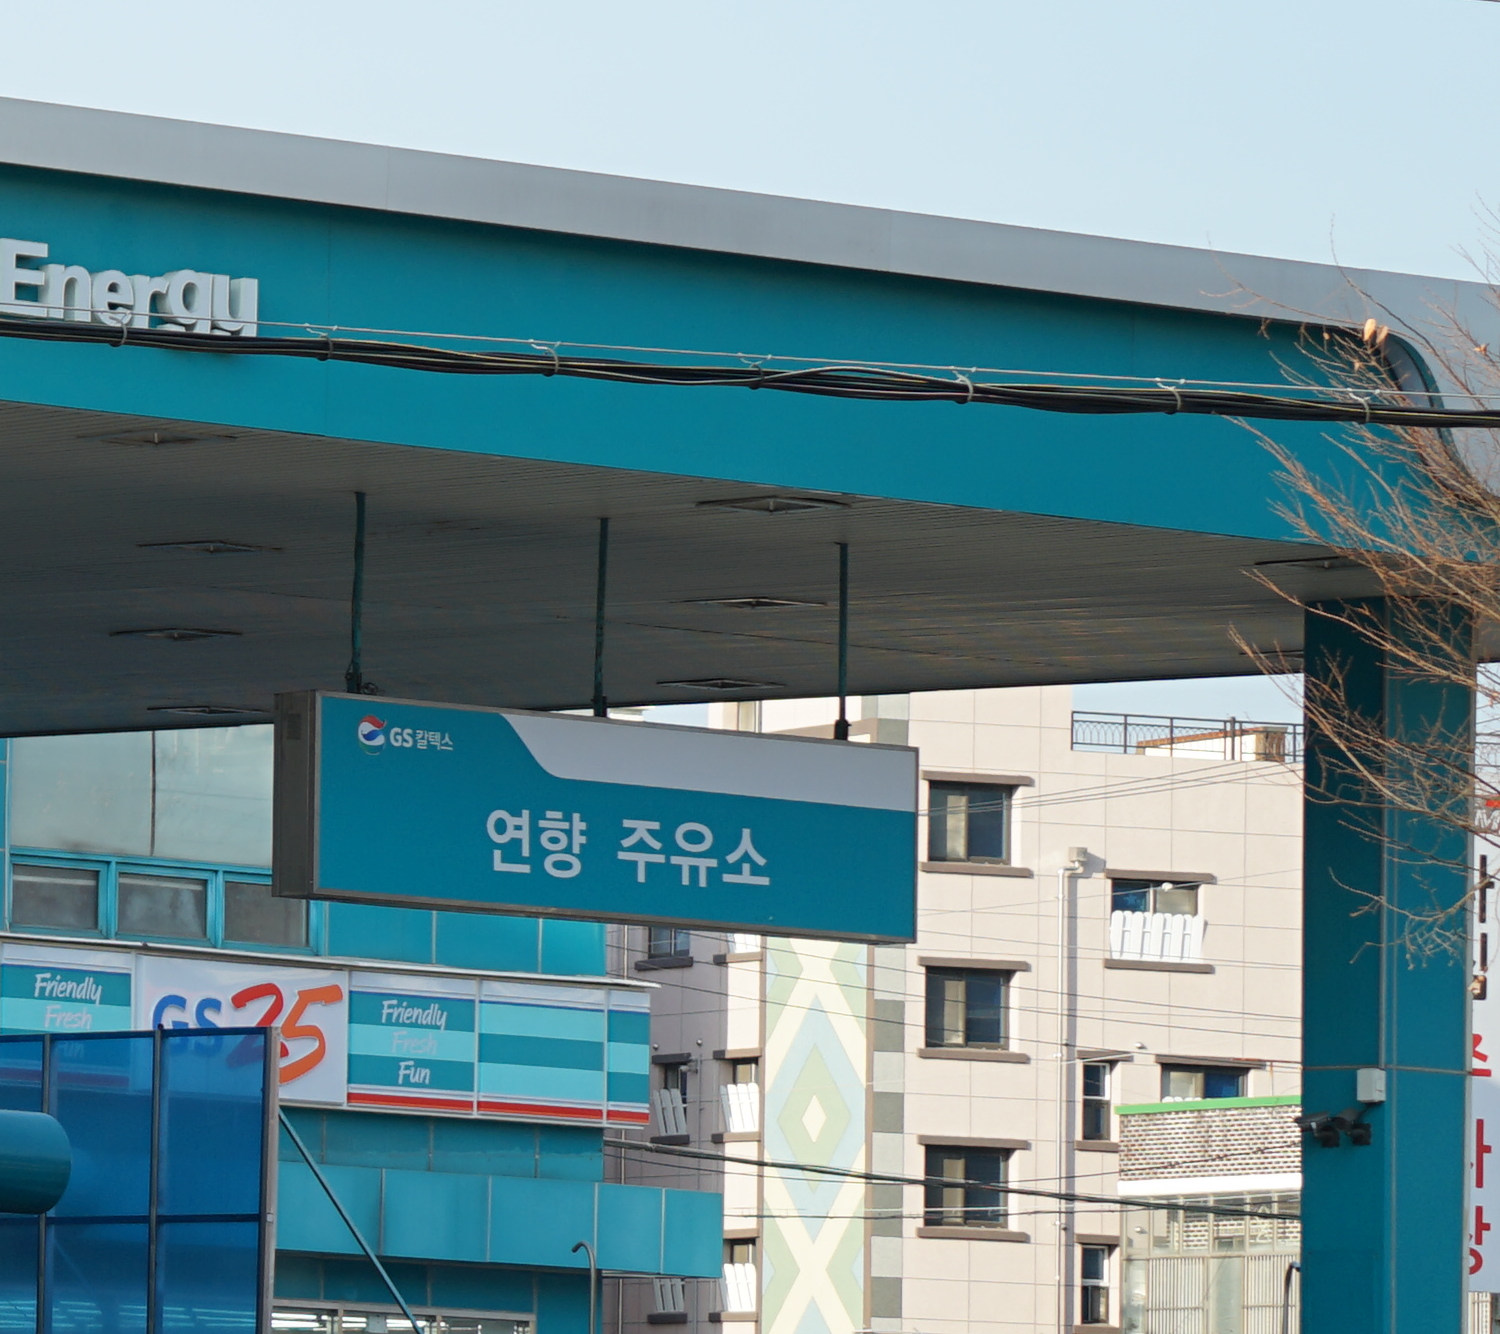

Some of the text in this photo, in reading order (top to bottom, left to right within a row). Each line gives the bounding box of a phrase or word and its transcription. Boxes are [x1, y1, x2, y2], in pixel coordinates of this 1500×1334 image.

[485, 808, 773, 888] 연향 주유소
[33, 973, 103, 1005] Friendly
[45, 1004, 93, 1031] Fresh
[381, 999, 447, 1030] Friendly
[151, 982, 343, 1086] GS25
[389, 1029, 438, 1056] Fresh
[397, 1059, 431, 1087] Fun
